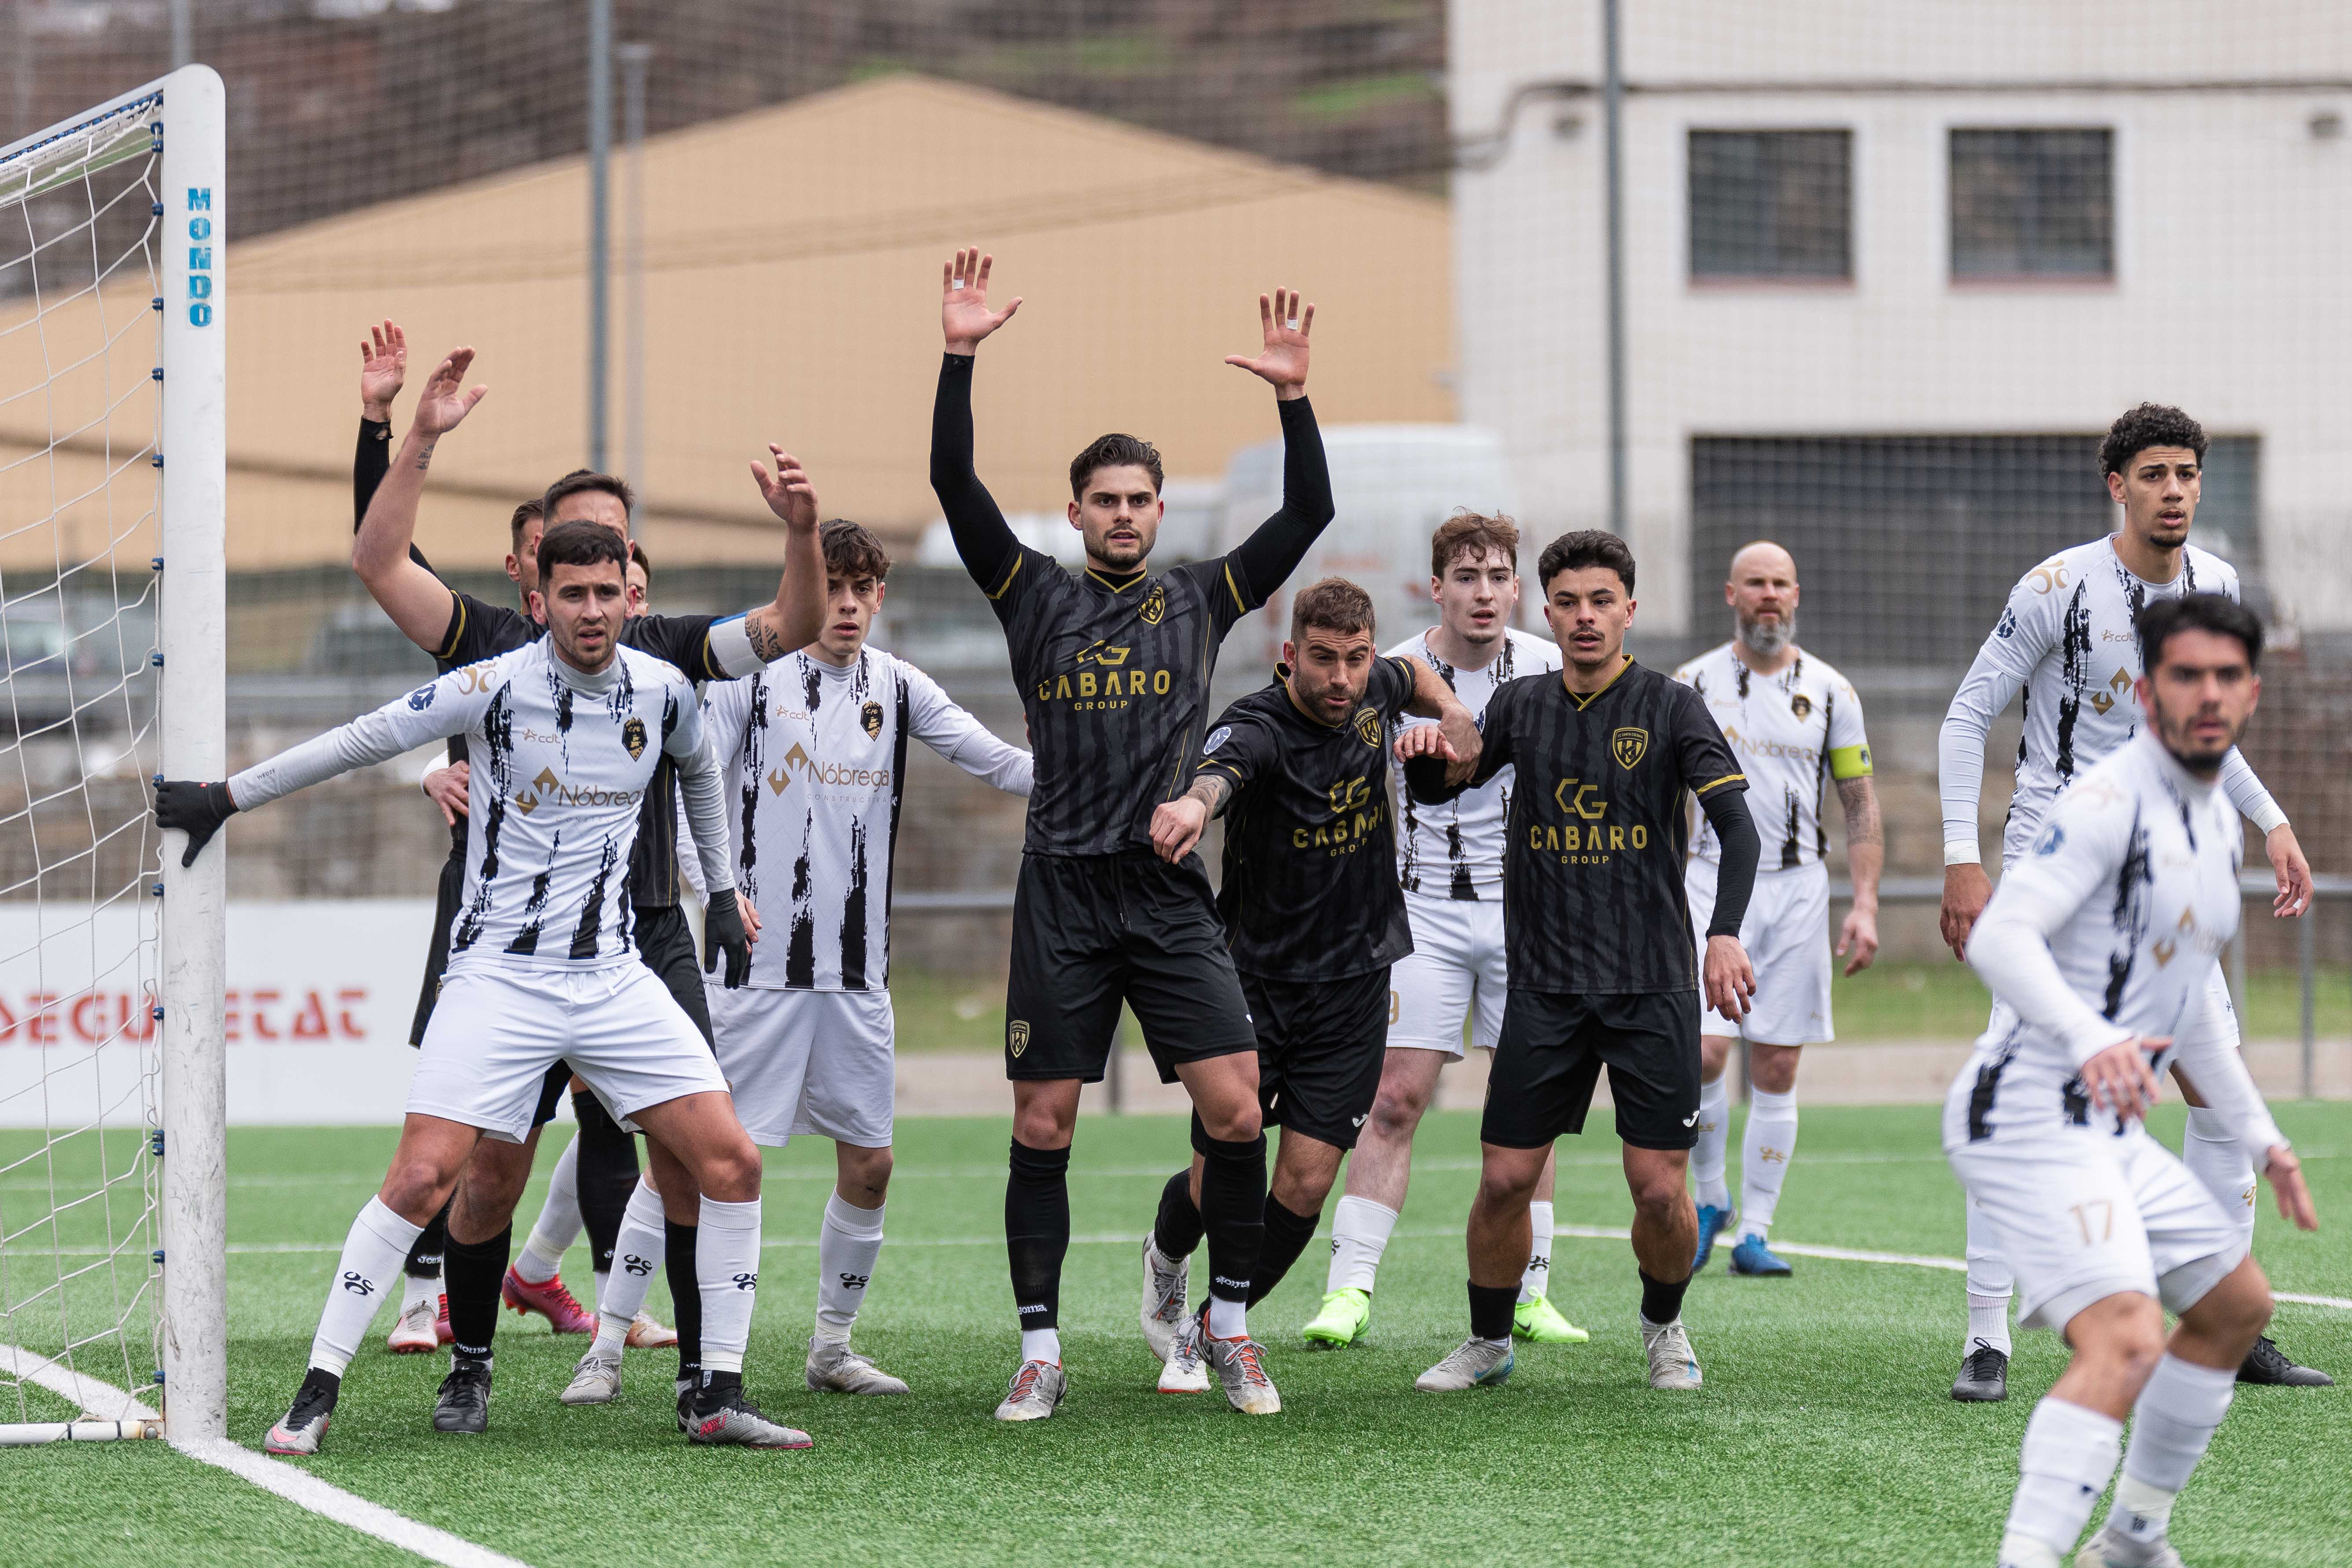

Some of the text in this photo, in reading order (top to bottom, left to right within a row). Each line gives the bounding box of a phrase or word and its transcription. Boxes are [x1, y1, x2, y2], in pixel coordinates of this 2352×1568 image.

[188, 188, 212, 327] MONDO
[2115, 632, 2135, 642] cdt
[1038, 670, 1170, 701] CABARO
[789, 711, 810, 721] cdt
[1075, 700, 1128, 710] GROUP
[538, 734, 560, 744] cdt
[808, 760, 889, 793] Nóbrega
[1293, 800, 1384, 848] CABAR
[1331, 838, 1367, 857] GROP
[1531, 825, 1647, 850] CABARO
[1561, 856, 1609, 864] GROUP
[2069, 1198, 2114, 1247] 17
